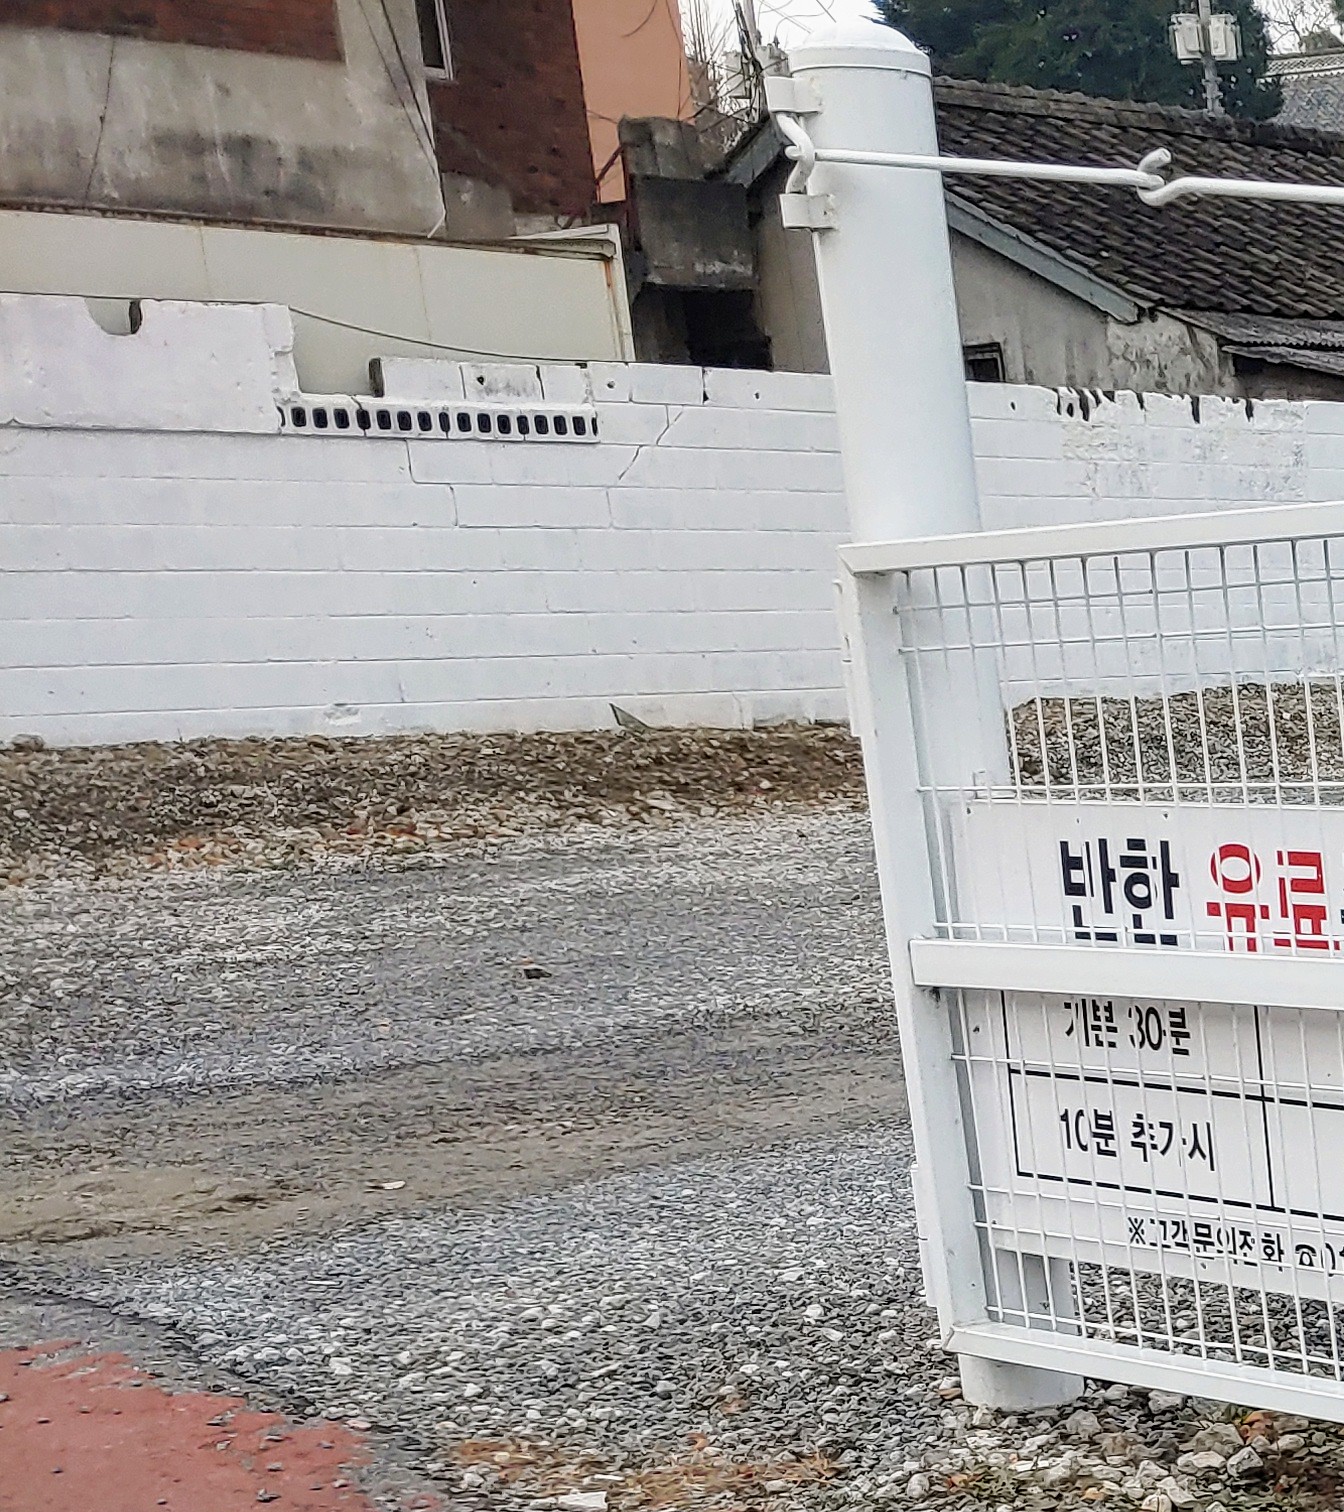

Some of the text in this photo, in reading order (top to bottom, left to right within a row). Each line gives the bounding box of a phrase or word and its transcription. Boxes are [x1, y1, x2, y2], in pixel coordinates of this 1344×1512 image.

[1060, 837, 1180, 947] 반한
[1063, 998, 1191, 1056] 기본 30분
[1060, 1108, 1117, 1158] 10분
